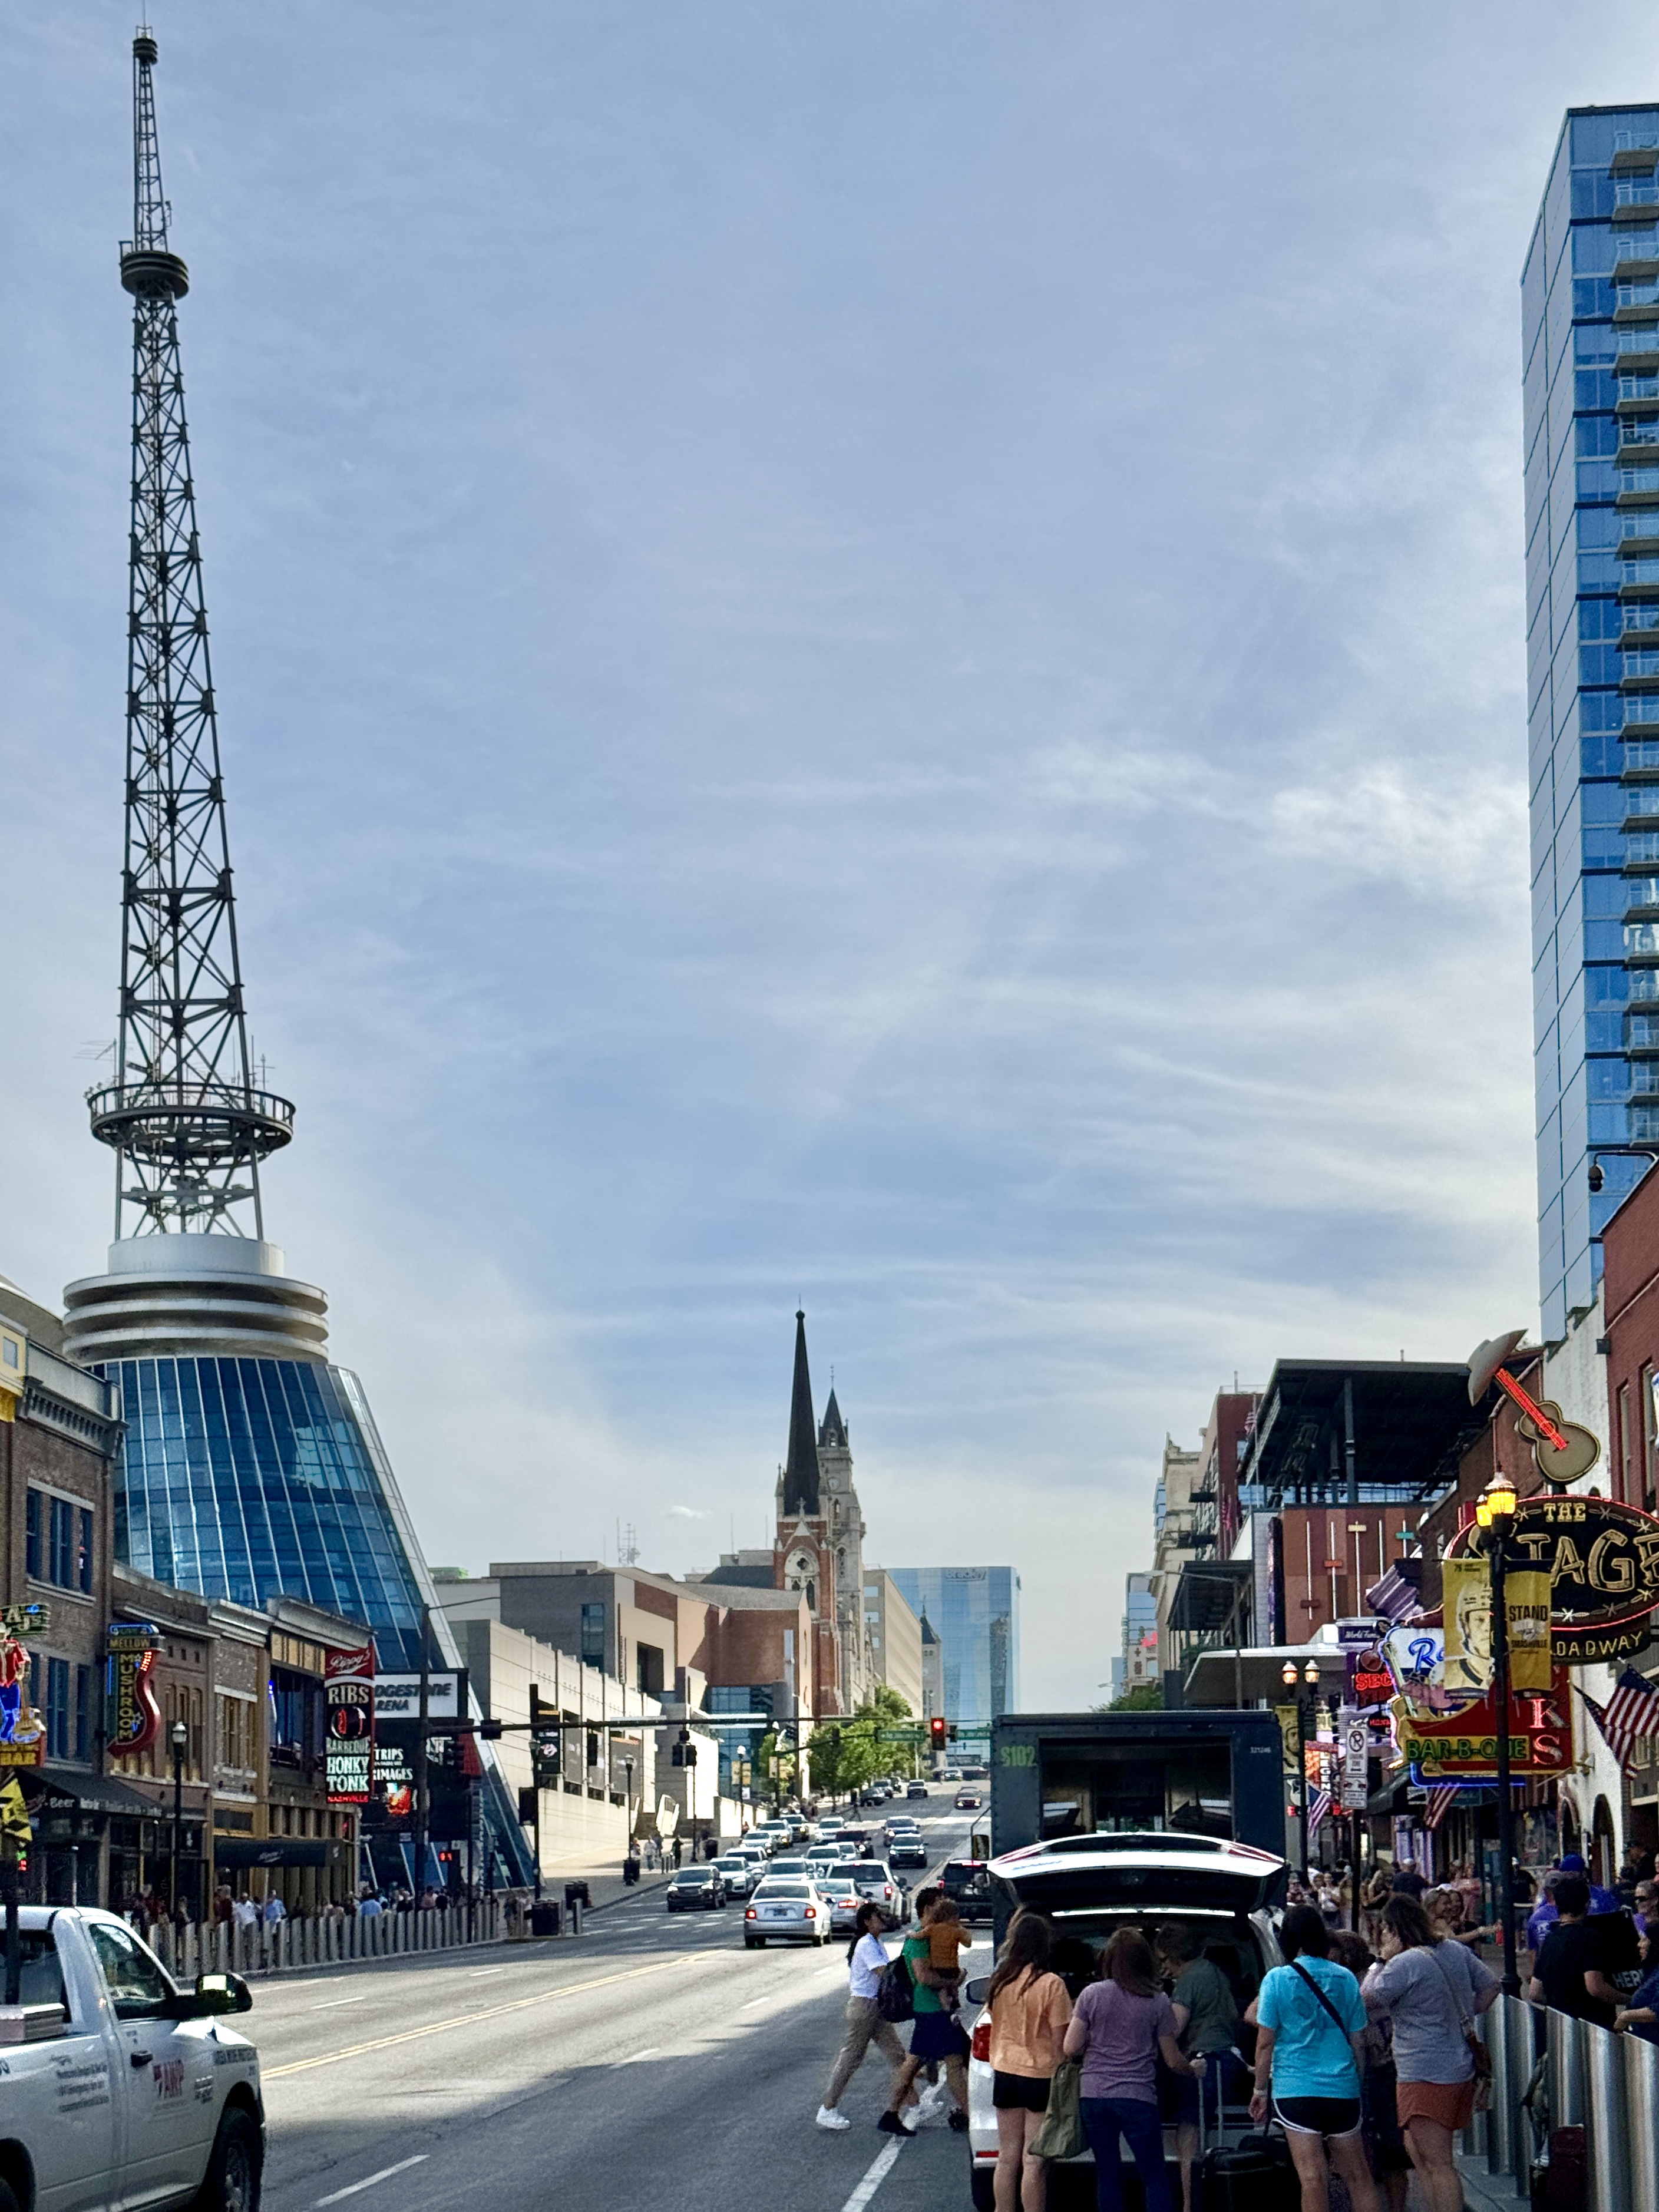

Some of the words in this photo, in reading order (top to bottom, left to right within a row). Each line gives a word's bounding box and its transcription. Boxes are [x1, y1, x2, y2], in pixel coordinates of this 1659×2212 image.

[1543, 1503, 1586, 1523] THE
[1509, 1605, 1548, 1622] STAND
[110, 1639, 150, 1649] MELLOW
[1551, 1631, 1643, 1656] OADWAY
[1356, 1673, 1393, 1690] SEC
[120, 1654, 134, 1740] MUSHROOM
[328, 1685, 369, 1704] RIBS
[375, 1699, 409, 1711] RENA
[326, 1736, 371, 1754] BARBEQUE
[326, 1756, 369, 1774] HONKY
[1001, 1746, 1037, 1767] S102
[326, 1775, 369, 1792] TONK
